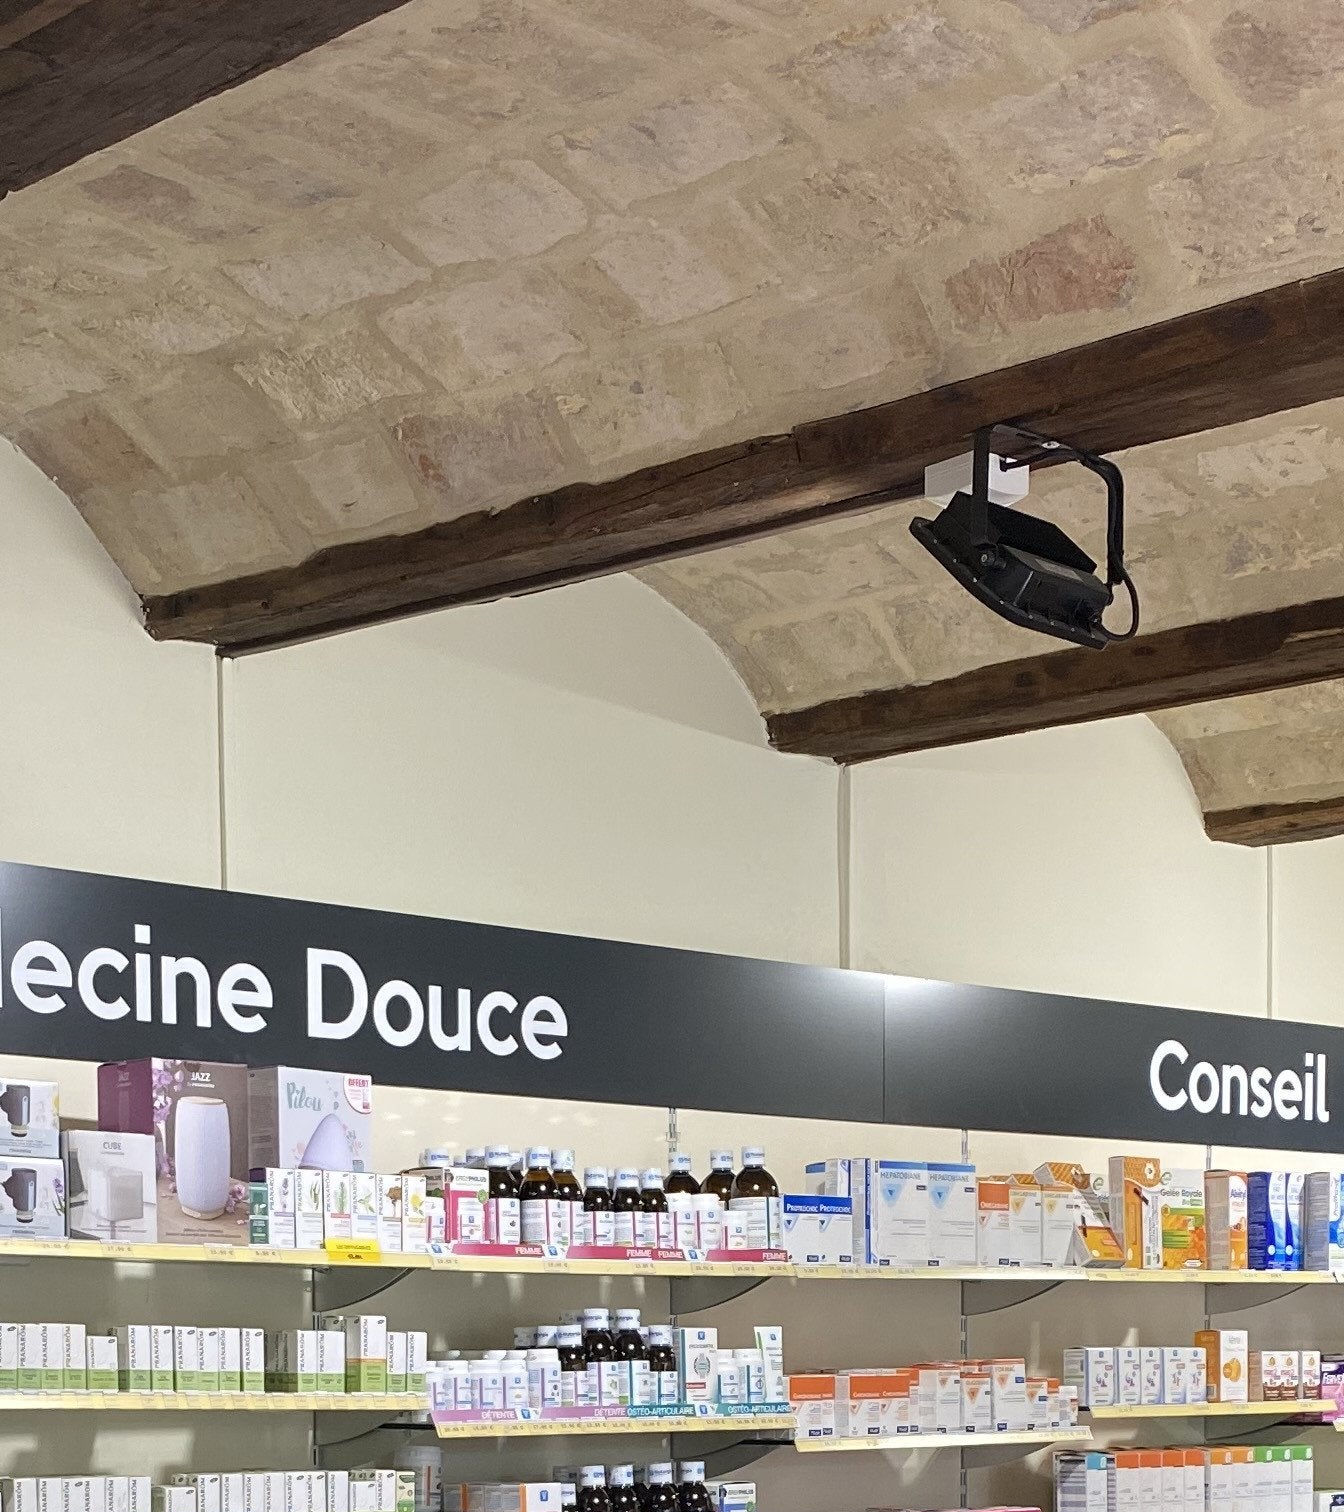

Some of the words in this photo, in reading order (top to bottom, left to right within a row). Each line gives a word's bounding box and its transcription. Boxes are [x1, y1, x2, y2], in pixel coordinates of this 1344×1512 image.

[306, 947, 569, 1060] Douce
[191, 1071, 211, 1082] JAZZ
[1150, 1039, 1330, 1123] Conseil
[515, 1247, 542, 1255] FEMME
[626, 1249, 652, 1257] FEMME
[657, 1250, 683, 1259] FEMME
